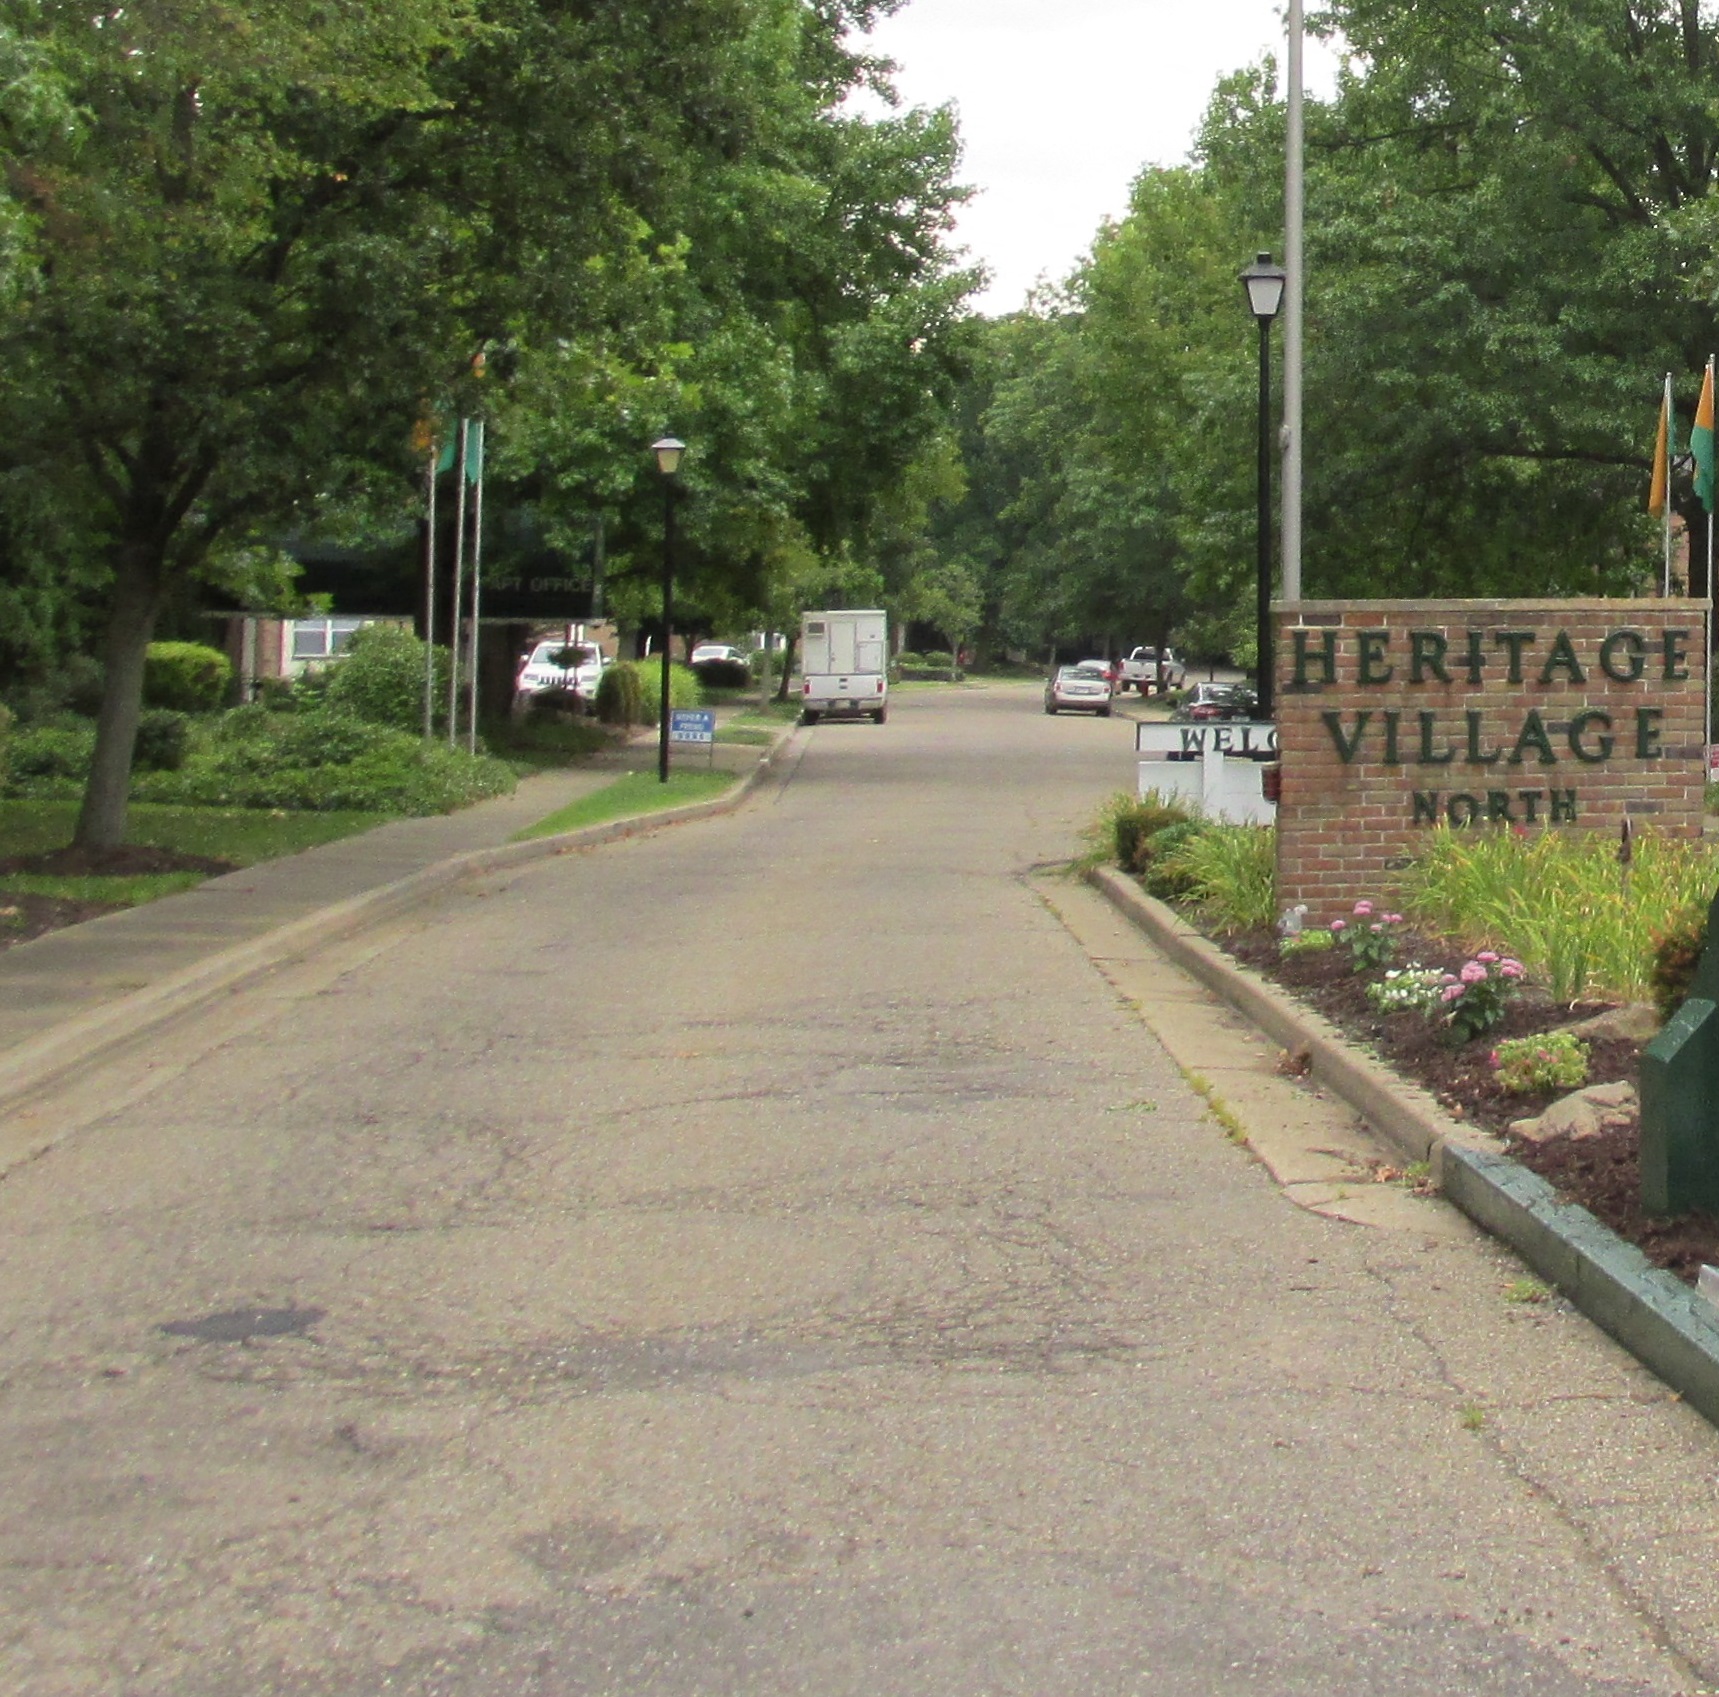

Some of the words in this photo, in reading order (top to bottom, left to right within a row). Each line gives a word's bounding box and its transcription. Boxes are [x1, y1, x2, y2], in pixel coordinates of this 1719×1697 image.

[530, 576, 593, 592] OFFICE
[1291, 628, 1690, 685] HERITAGE
[1322, 706, 1664, 765] VILLAGE
[1412, 789, 1577, 825] NORTH
